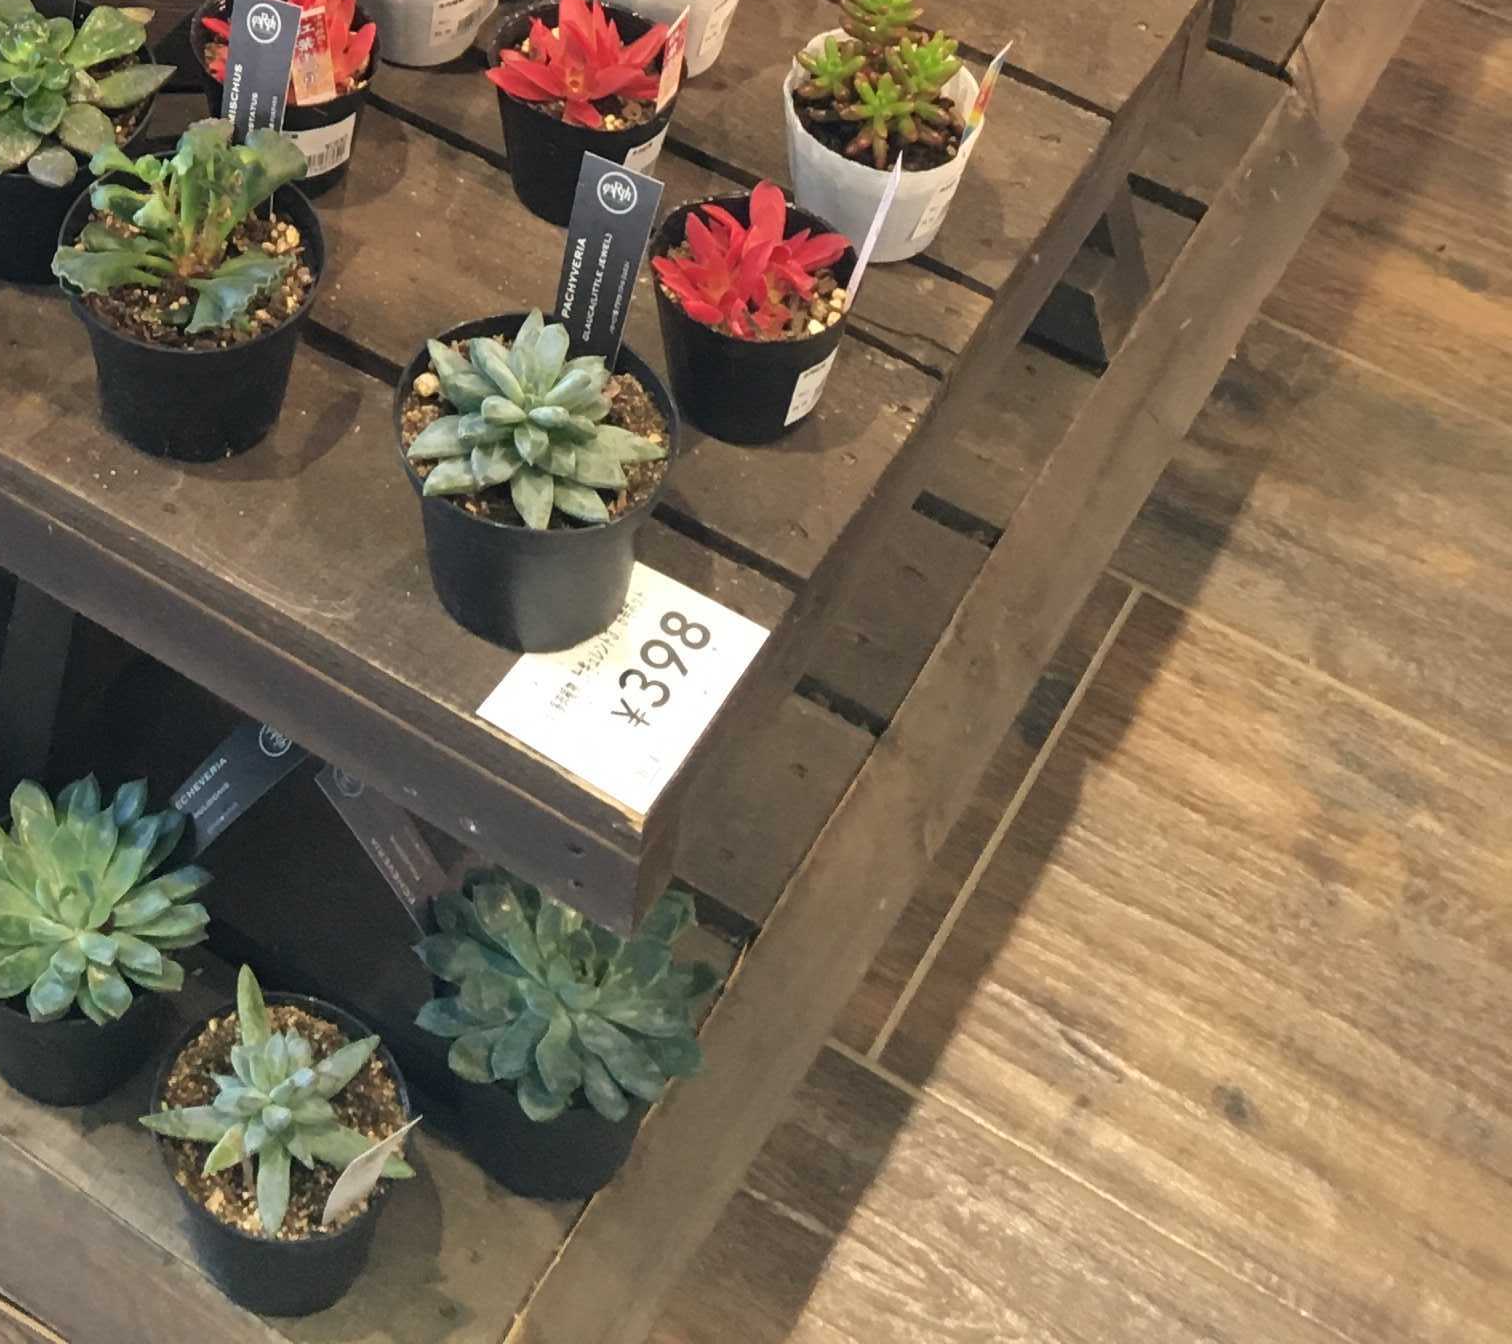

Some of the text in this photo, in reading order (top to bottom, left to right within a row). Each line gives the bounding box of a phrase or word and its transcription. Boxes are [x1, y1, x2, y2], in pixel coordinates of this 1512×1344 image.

[561, 236, 587, 319] PACHYVERIA
[611, 610, 711, 728] ¥398
[175, 758, 228, 810] ECHEVERIA
